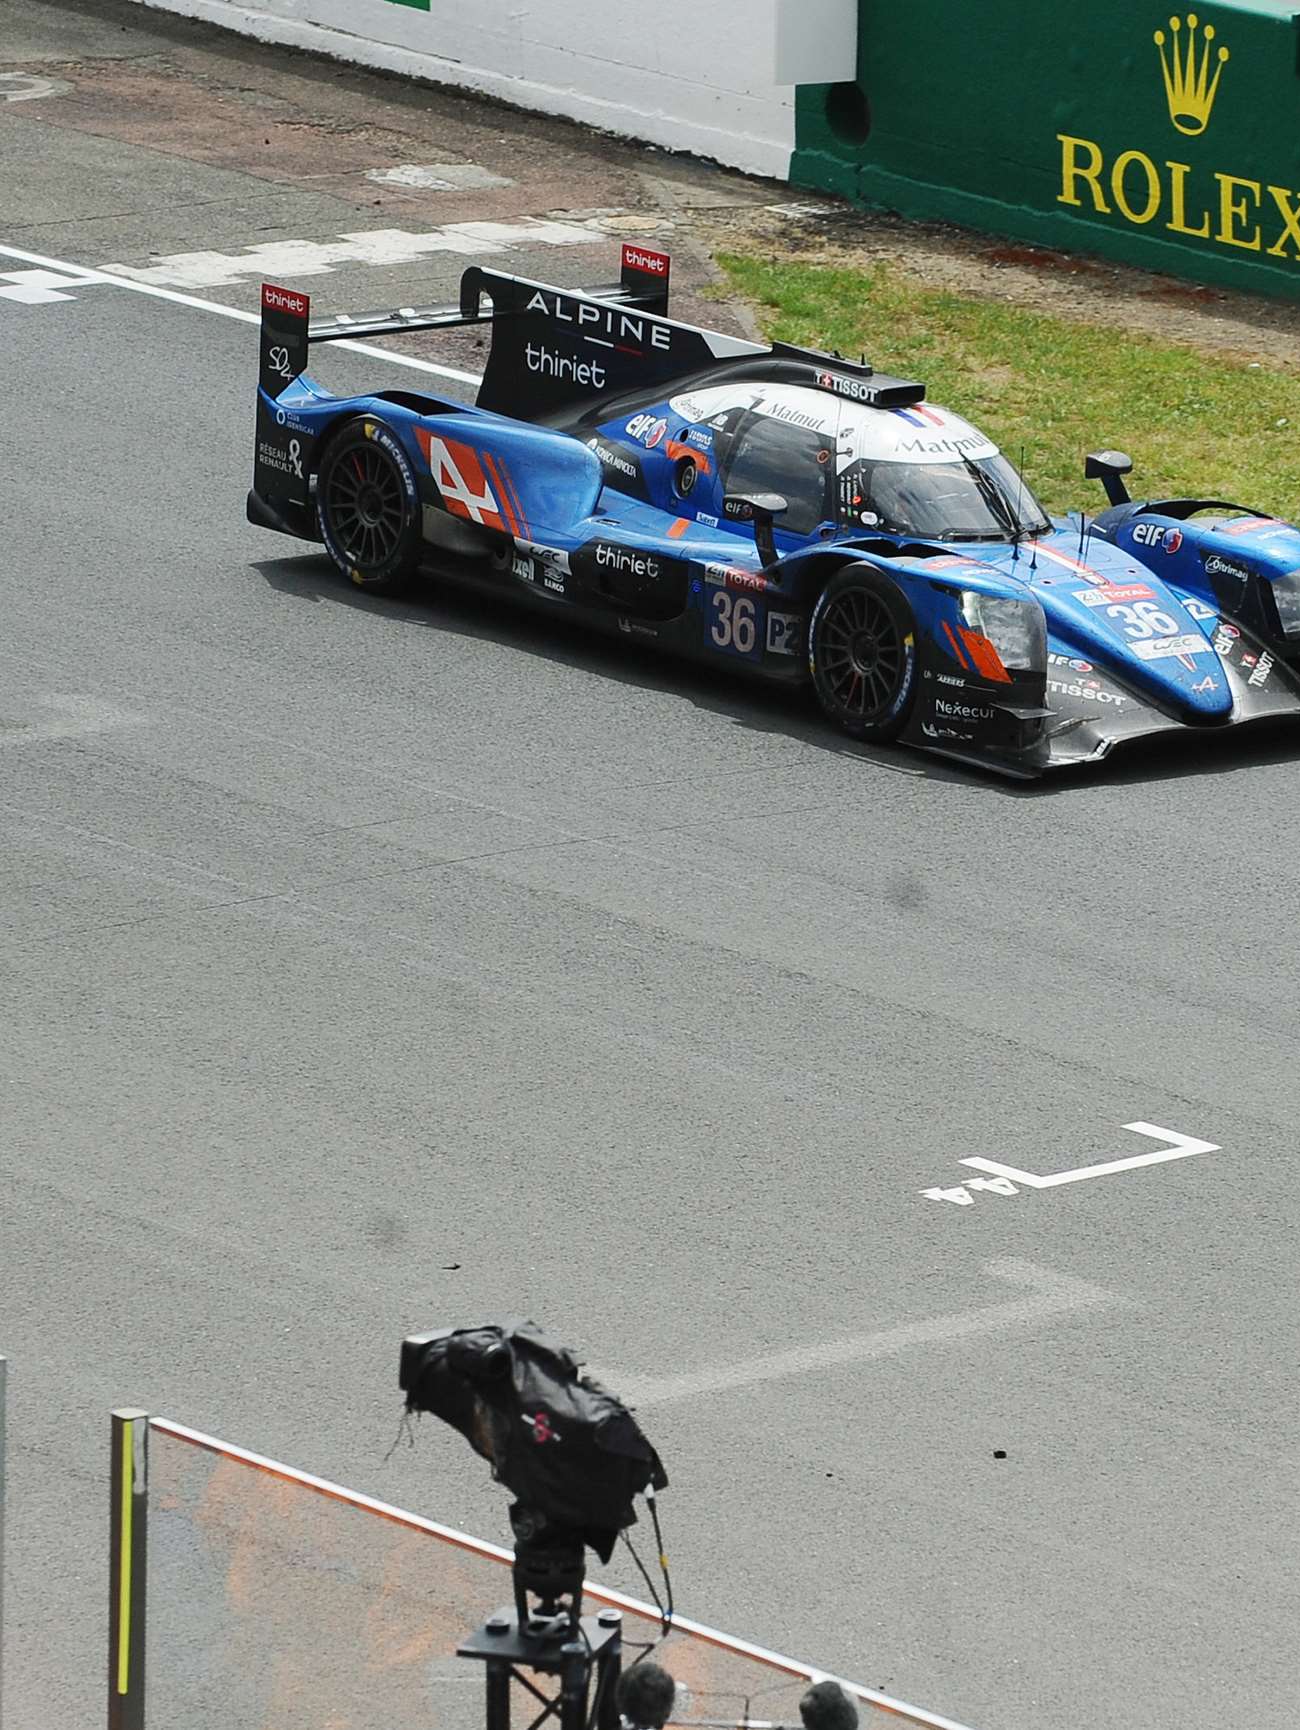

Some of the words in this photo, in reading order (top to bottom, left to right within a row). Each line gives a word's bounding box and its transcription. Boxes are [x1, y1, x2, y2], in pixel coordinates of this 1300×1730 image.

[623, 250, 664, 272] thiriet
[265, 289, 304, 312] thiriet
[526, 291, 671, 350] ALPINE
[525, 342, 605, 389] thiriet
[832, 377, 878, 403] TISSOT
[765, 402, 826, 431] Matmut
[259, 442, 287, 461] RÉSEAU
[259, 454, 294, 473] RENAULT
[1132, 524, 1163, 546] elf
[595, 544, 659, 578] thiriet
[729, 570, 766, 593] TOTAL
[1103, 588, 1152, 598] TOTAL
[711, 591, 756, 653] 36
[769, 617, 801, 651] P2
[1106, 601, 1179, 638] 36
[1247, 650, 1275, 688] TISSOT
[1047, 679, 1126, 707] TISSOT
[935, 698, 996, 719] Nexecur
[918, 1176, 1020, 1206] 44
